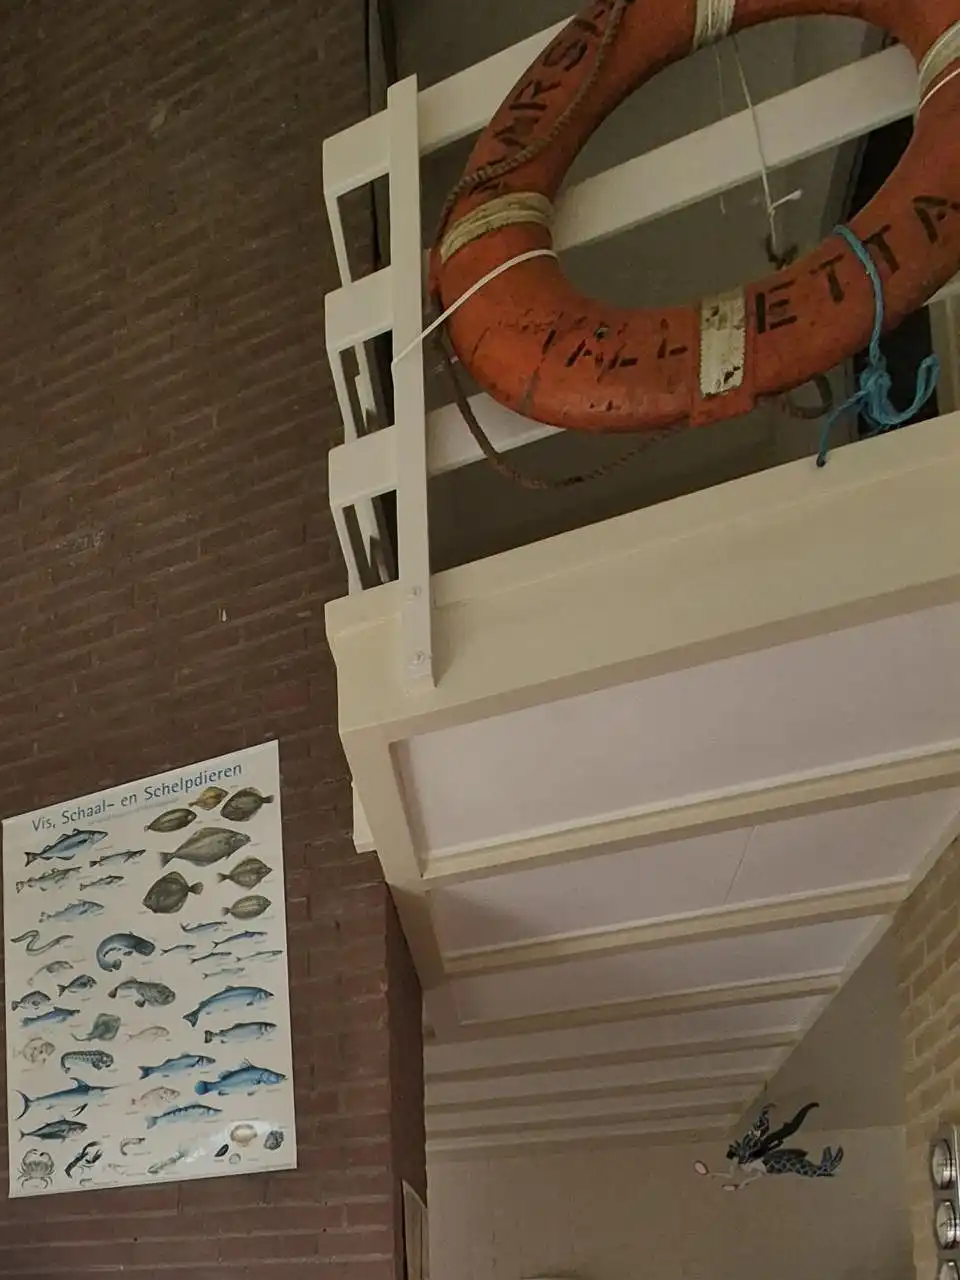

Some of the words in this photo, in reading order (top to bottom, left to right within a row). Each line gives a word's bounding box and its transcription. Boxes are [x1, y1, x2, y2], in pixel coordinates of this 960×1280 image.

[31, 818, 56, 832] Vis,
[61, 802, 115, 825] Schaal-
[120, 792, 138, 807] en
[143, 764, 243, 801] Schelpdieren
